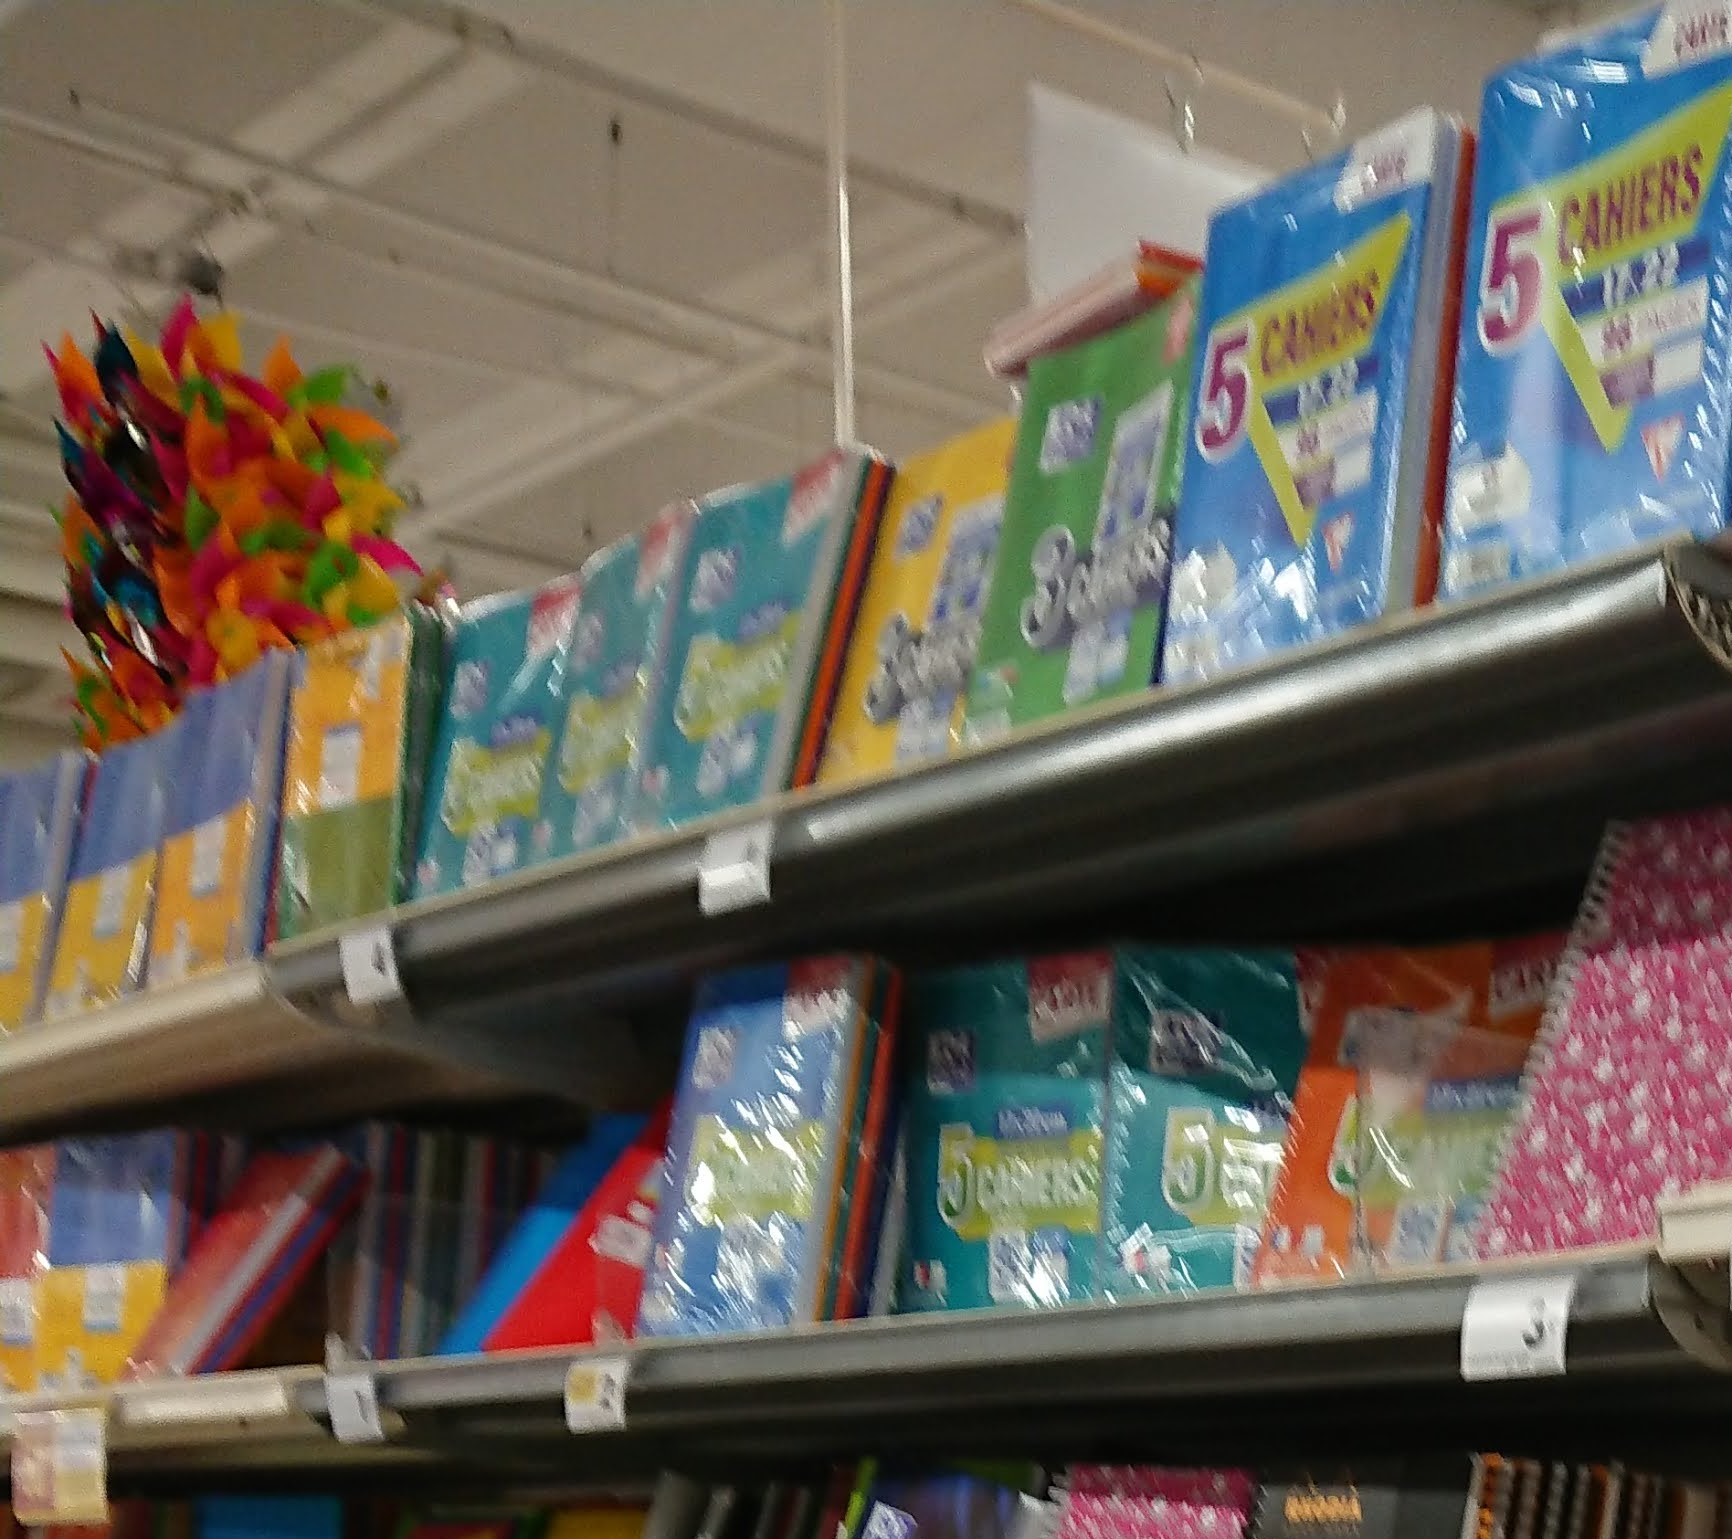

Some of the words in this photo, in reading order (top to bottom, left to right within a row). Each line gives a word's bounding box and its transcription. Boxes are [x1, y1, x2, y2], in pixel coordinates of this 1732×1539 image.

[1558, 146, 1703, 266] CAHIERS
[1261, 269, 1381, 377] CAHIERS
[1481, 204, 1543, 350] 5
[1201, 327, 1251, 454] 5
